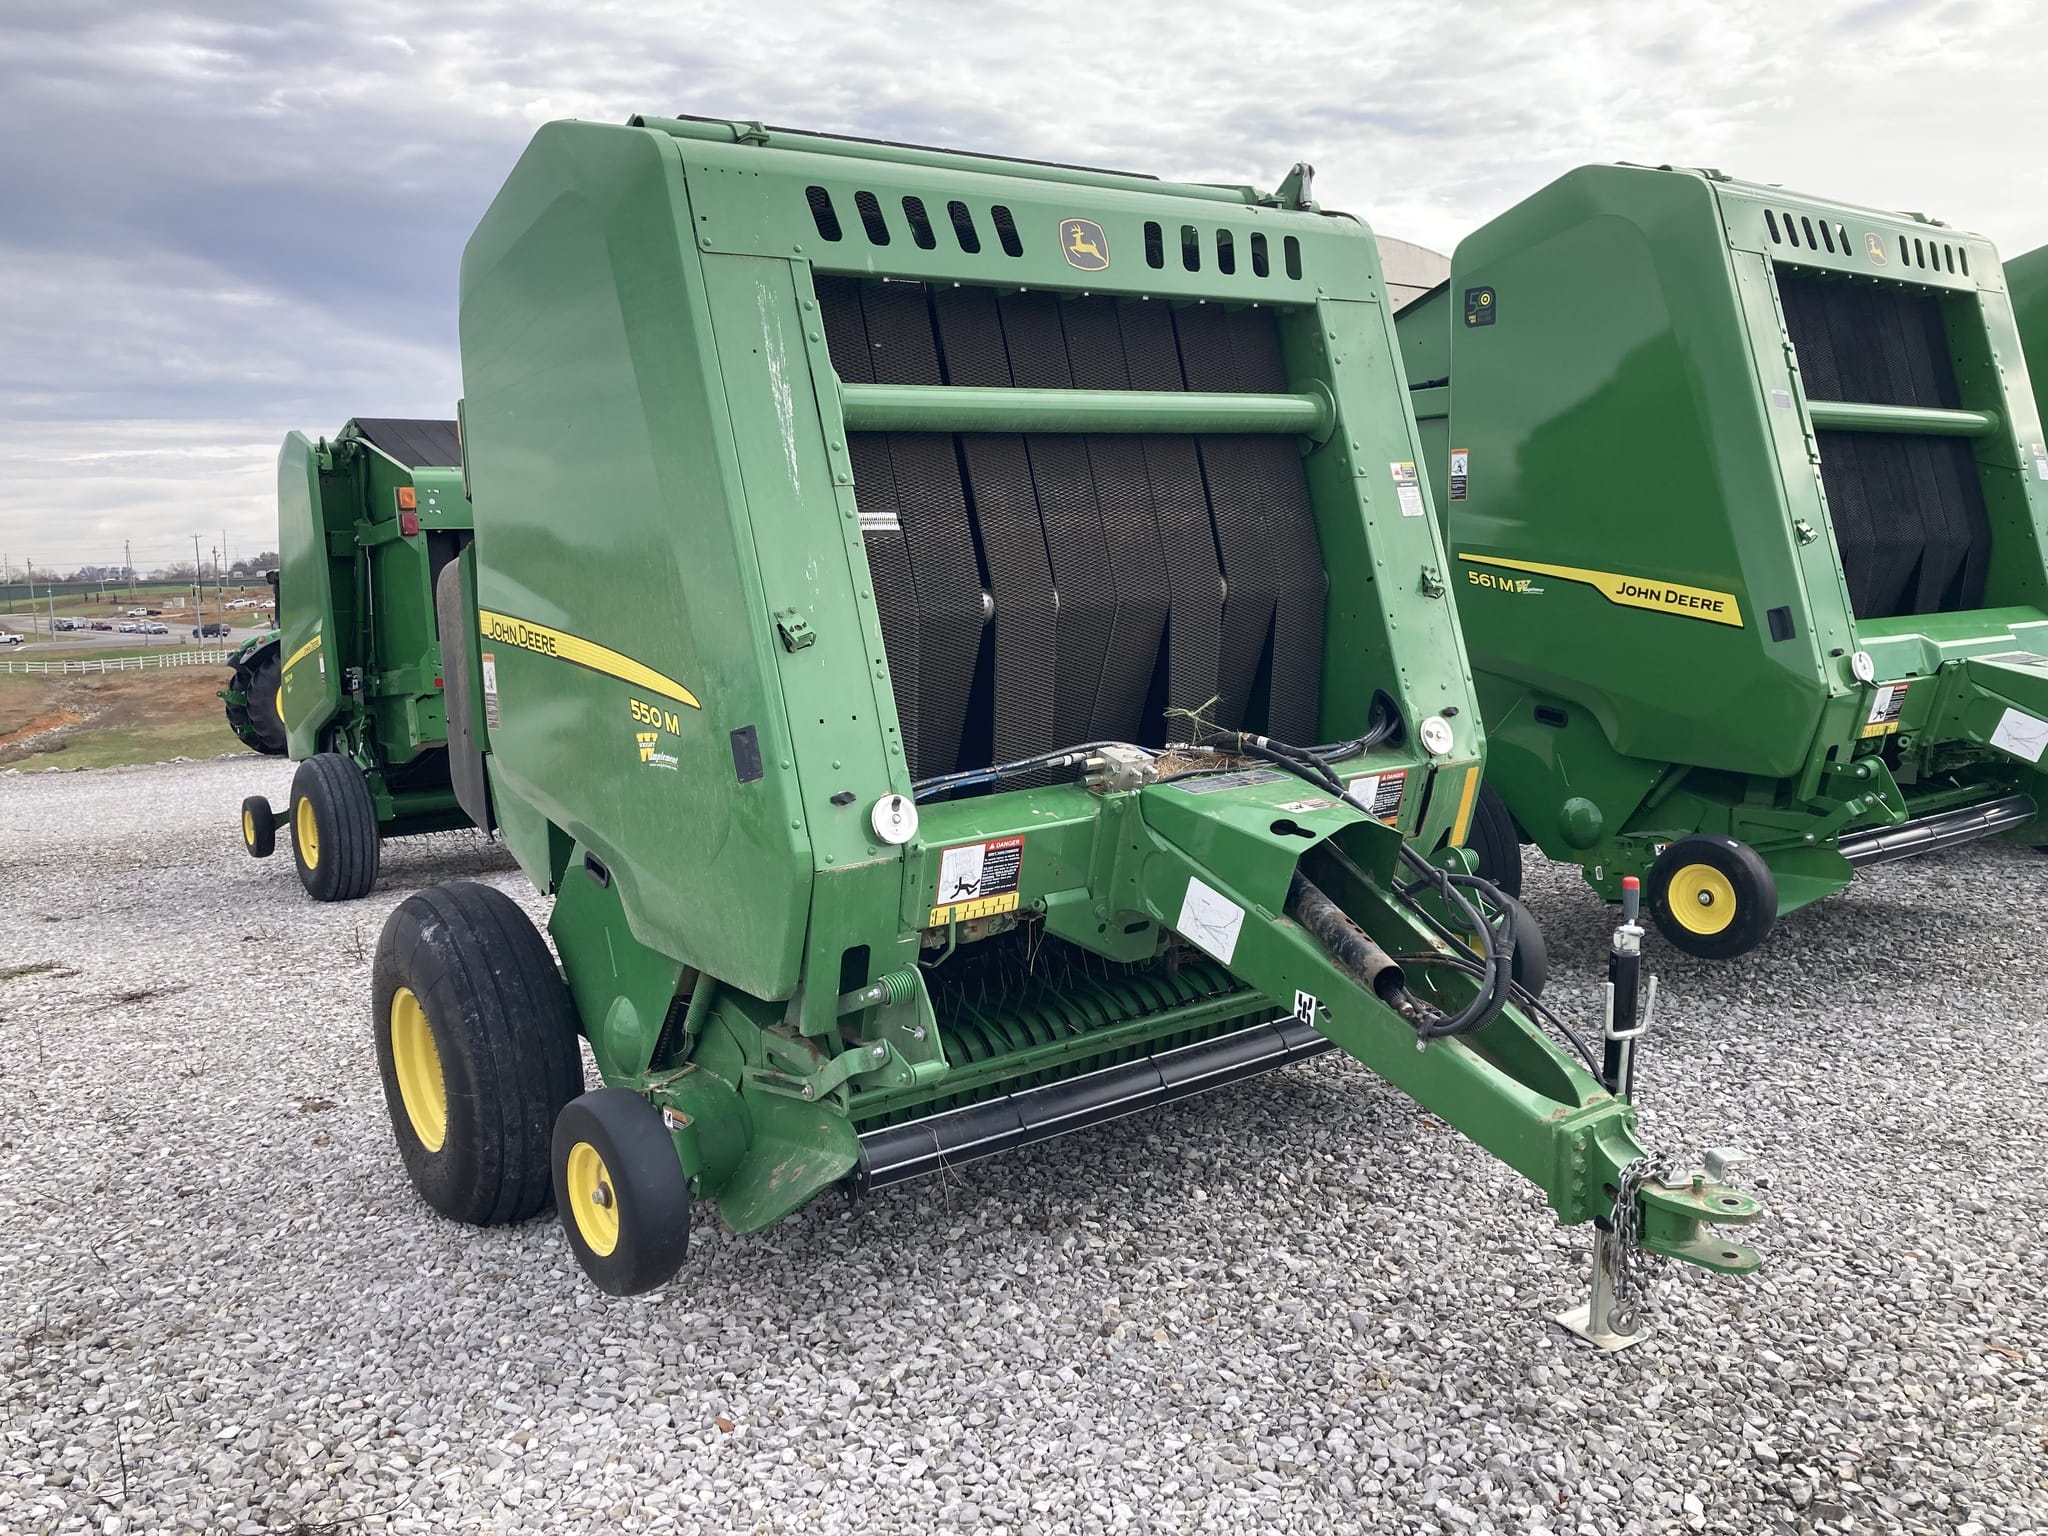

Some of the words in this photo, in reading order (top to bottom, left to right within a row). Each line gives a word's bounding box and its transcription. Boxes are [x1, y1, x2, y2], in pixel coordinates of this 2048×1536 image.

[1468, 571, 1496, 589] 561
[1500, 577, 1514, 593] M
[1616, 582, 1661, 602] JOHN
[1664, 590, 1724, 613] DEERE
[488, 616, 518, 643] JOHN
[519, 624, 557, 655] DEERE
[630, 698, 662, 729] 550
[664, 711, 681, 736] M
[996, 839, 1020, 849] DANGER
